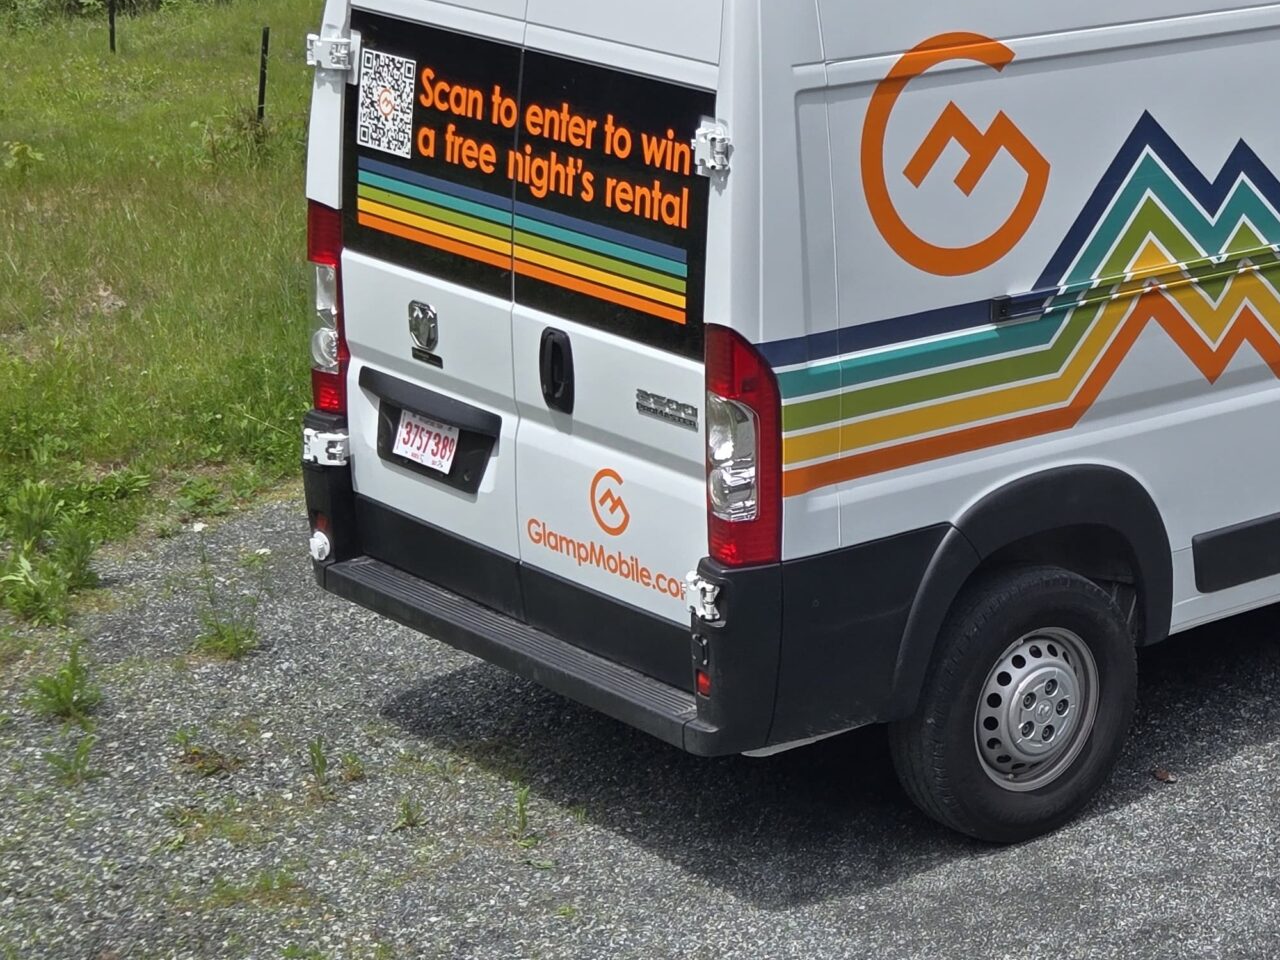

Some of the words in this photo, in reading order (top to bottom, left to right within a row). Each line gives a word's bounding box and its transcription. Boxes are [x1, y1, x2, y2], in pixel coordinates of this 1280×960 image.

[418, 67, 485, 121] Scan
[490, 84, 520, 129] to
[524, 102, 598, 150] enter
[603, 113, 634, 160] to
[641, 128, 692, 176] win
[416, 125, 437, 158] a
[443, 122, 498, 175] free
[506, 143, 596, 203] night's
[604, 176, 690, 229] rental
[401, 421, 456, 462] 3757389
